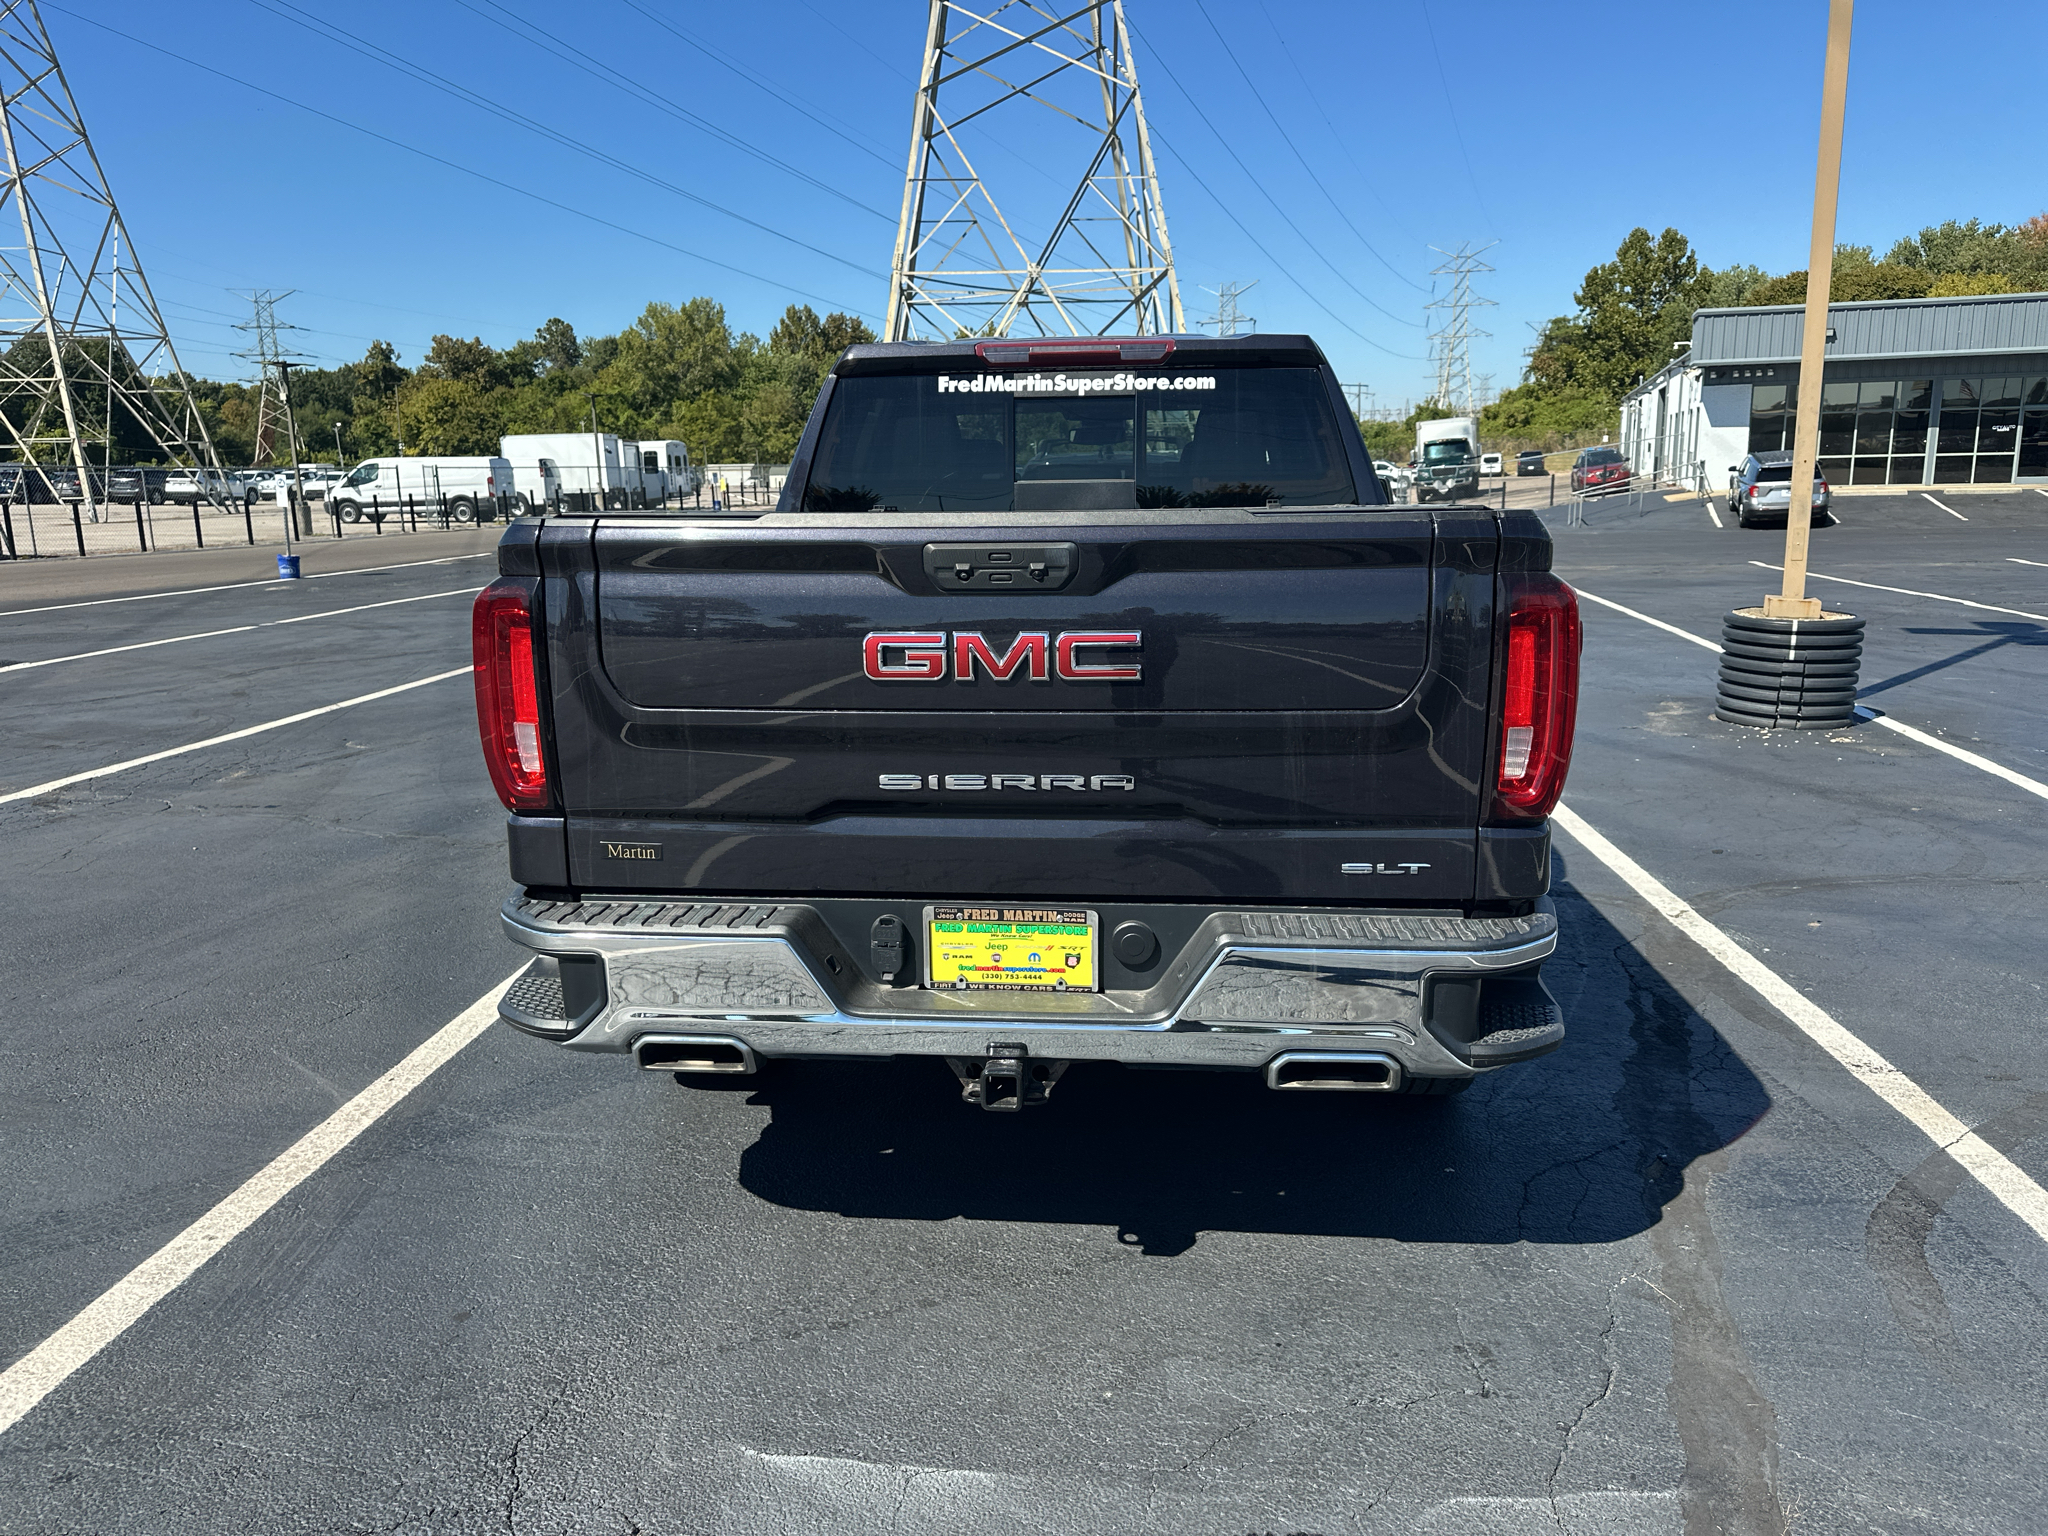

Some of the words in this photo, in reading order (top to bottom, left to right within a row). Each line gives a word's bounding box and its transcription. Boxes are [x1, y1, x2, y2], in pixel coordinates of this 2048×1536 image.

[938, 374, 1216, 396] FredMartinSuperStore.com
[863, 630, 1142, 681] GMC
[878, 774, 1135, 791] SIERRA
[608, 844, 656, 859] Martin
[1341, 863, 1431, 875] SLT
[963, 908, 998, 920] FRED
[1003, 910, 1057, 922] MARTIN
[935, 923, 963, 932] FRED
[967, 923, 1012, 933] MARTIN
[1016, 924, 1088, 935] SUPERSTORE
[985, 942, 1008, 951] Jeep
